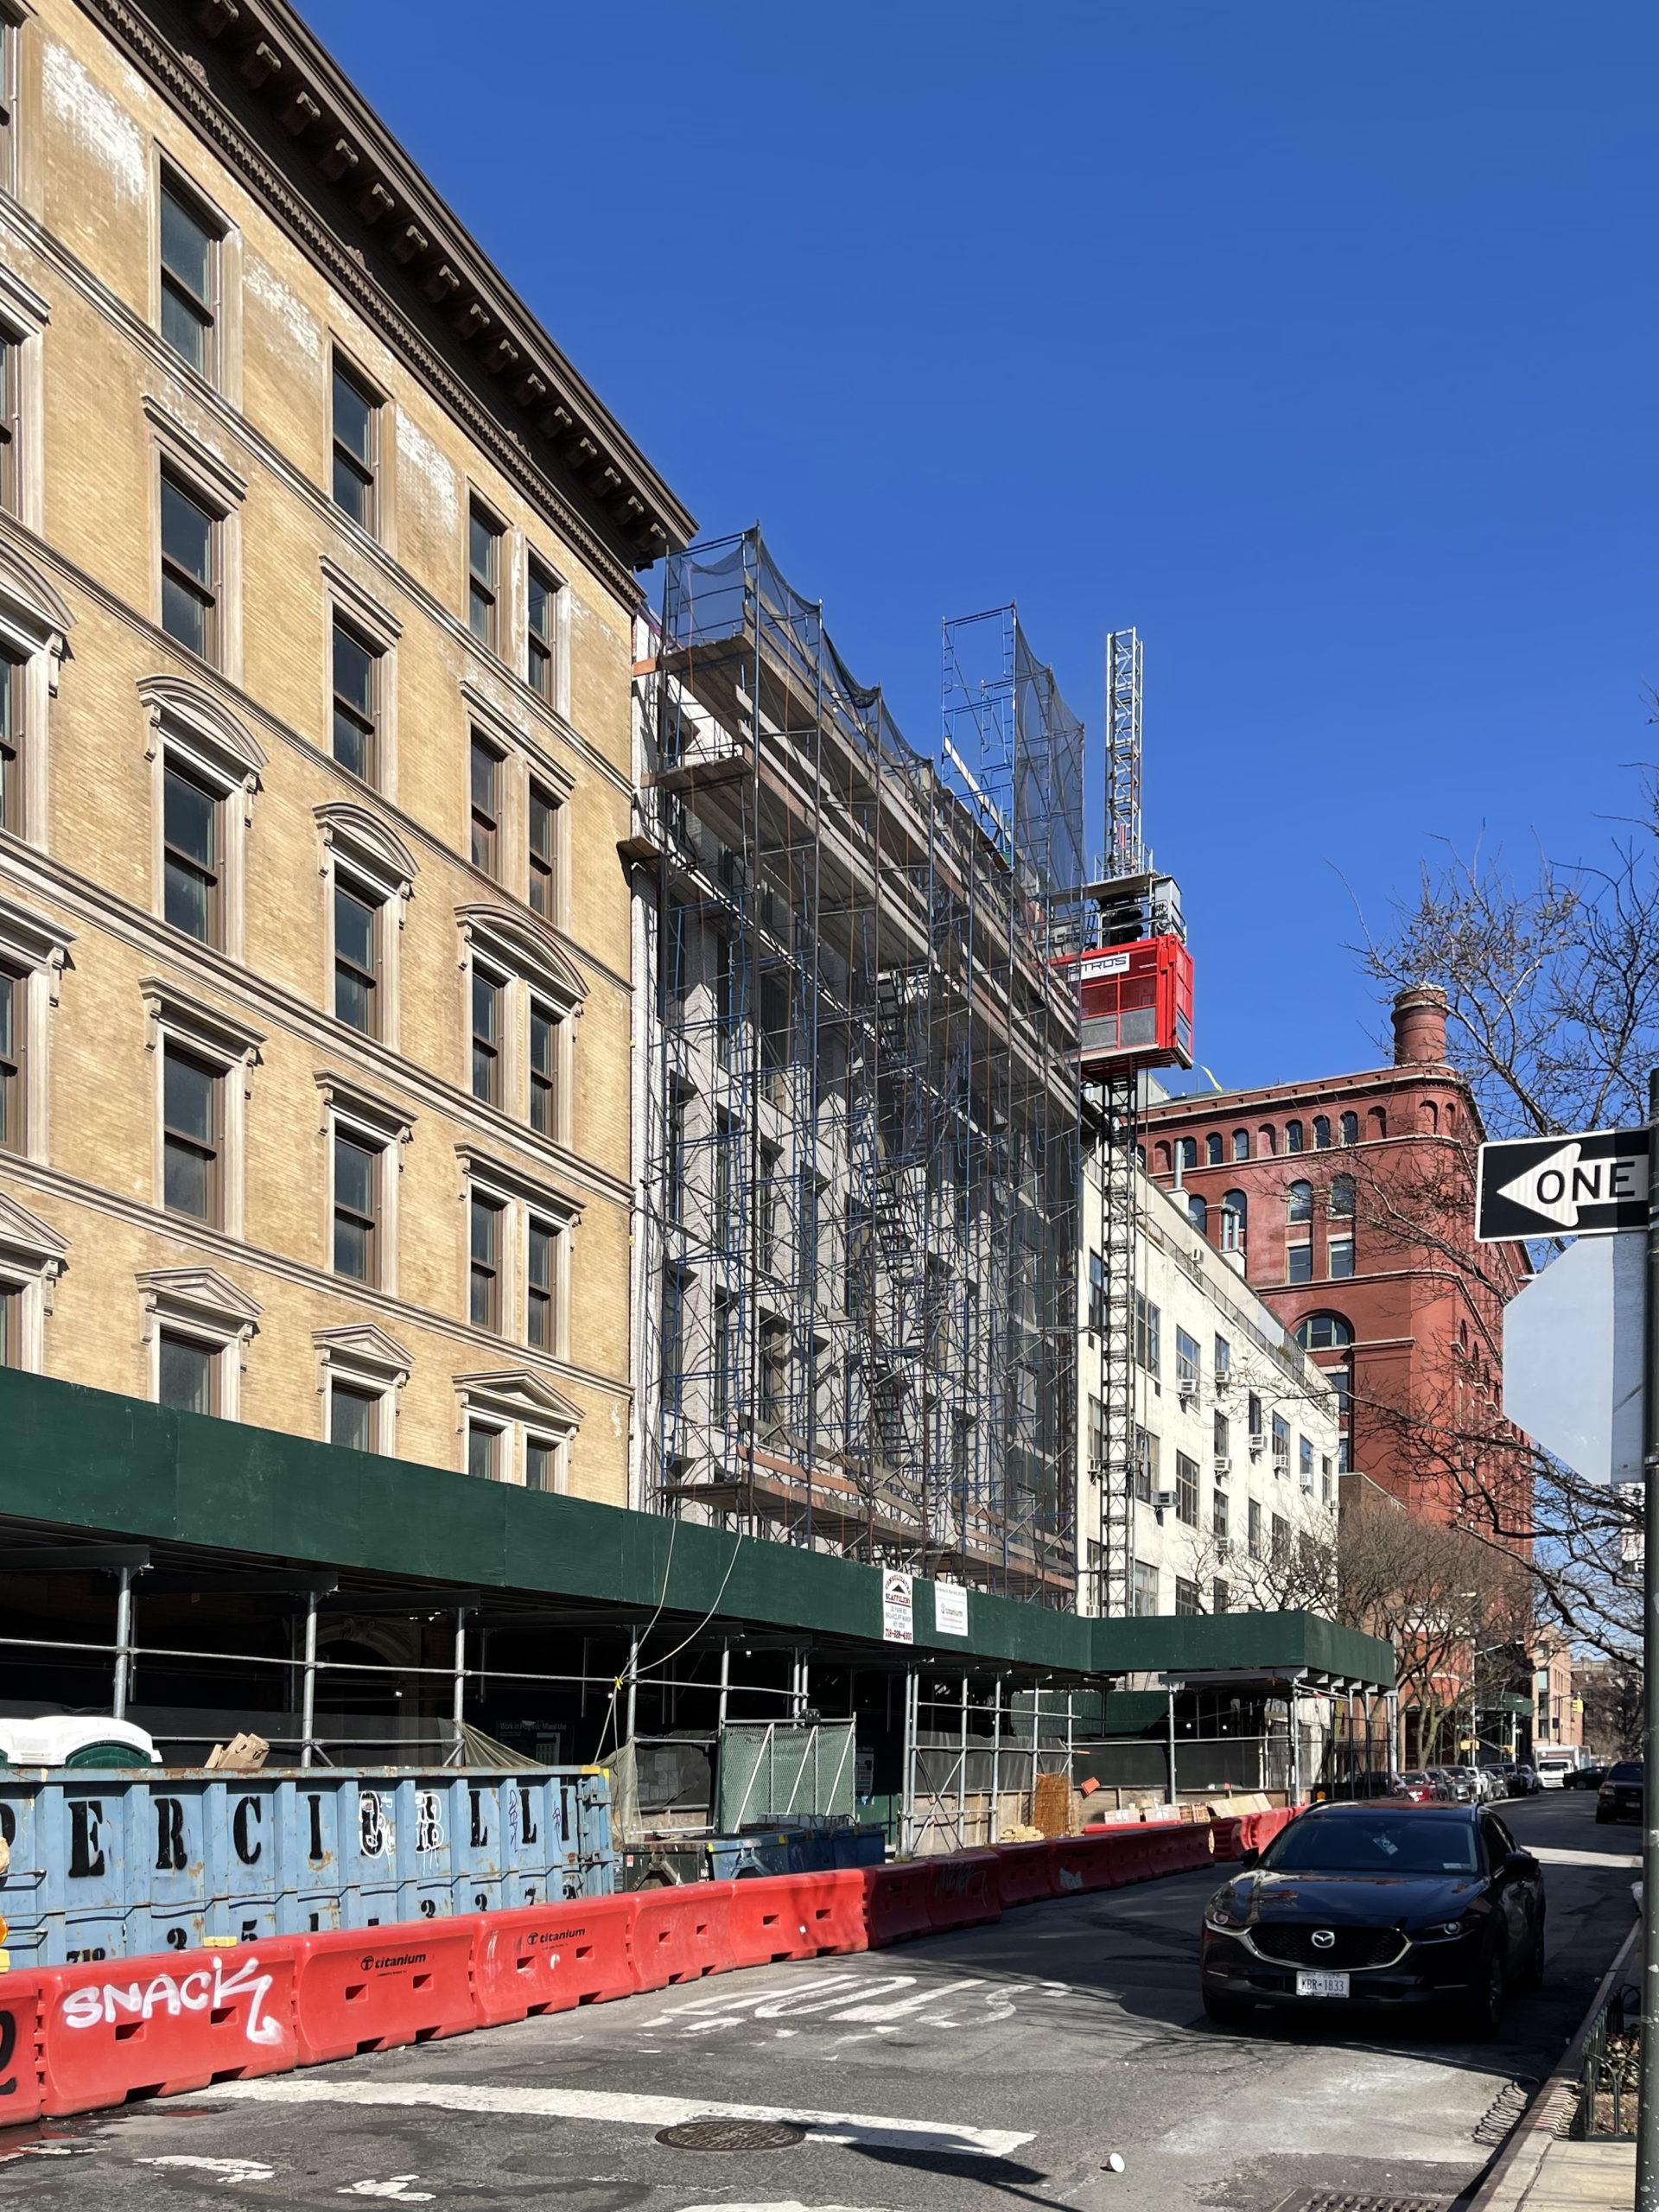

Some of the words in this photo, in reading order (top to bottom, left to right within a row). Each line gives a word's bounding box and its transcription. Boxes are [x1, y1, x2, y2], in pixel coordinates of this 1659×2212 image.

[1536, 1160, 1636, 1205] ONE
[539, 1928, 586, 1943] titanium
[374, 1954, 427, 1969] titanium
[62, 1956, 283, 2045] SNACK
